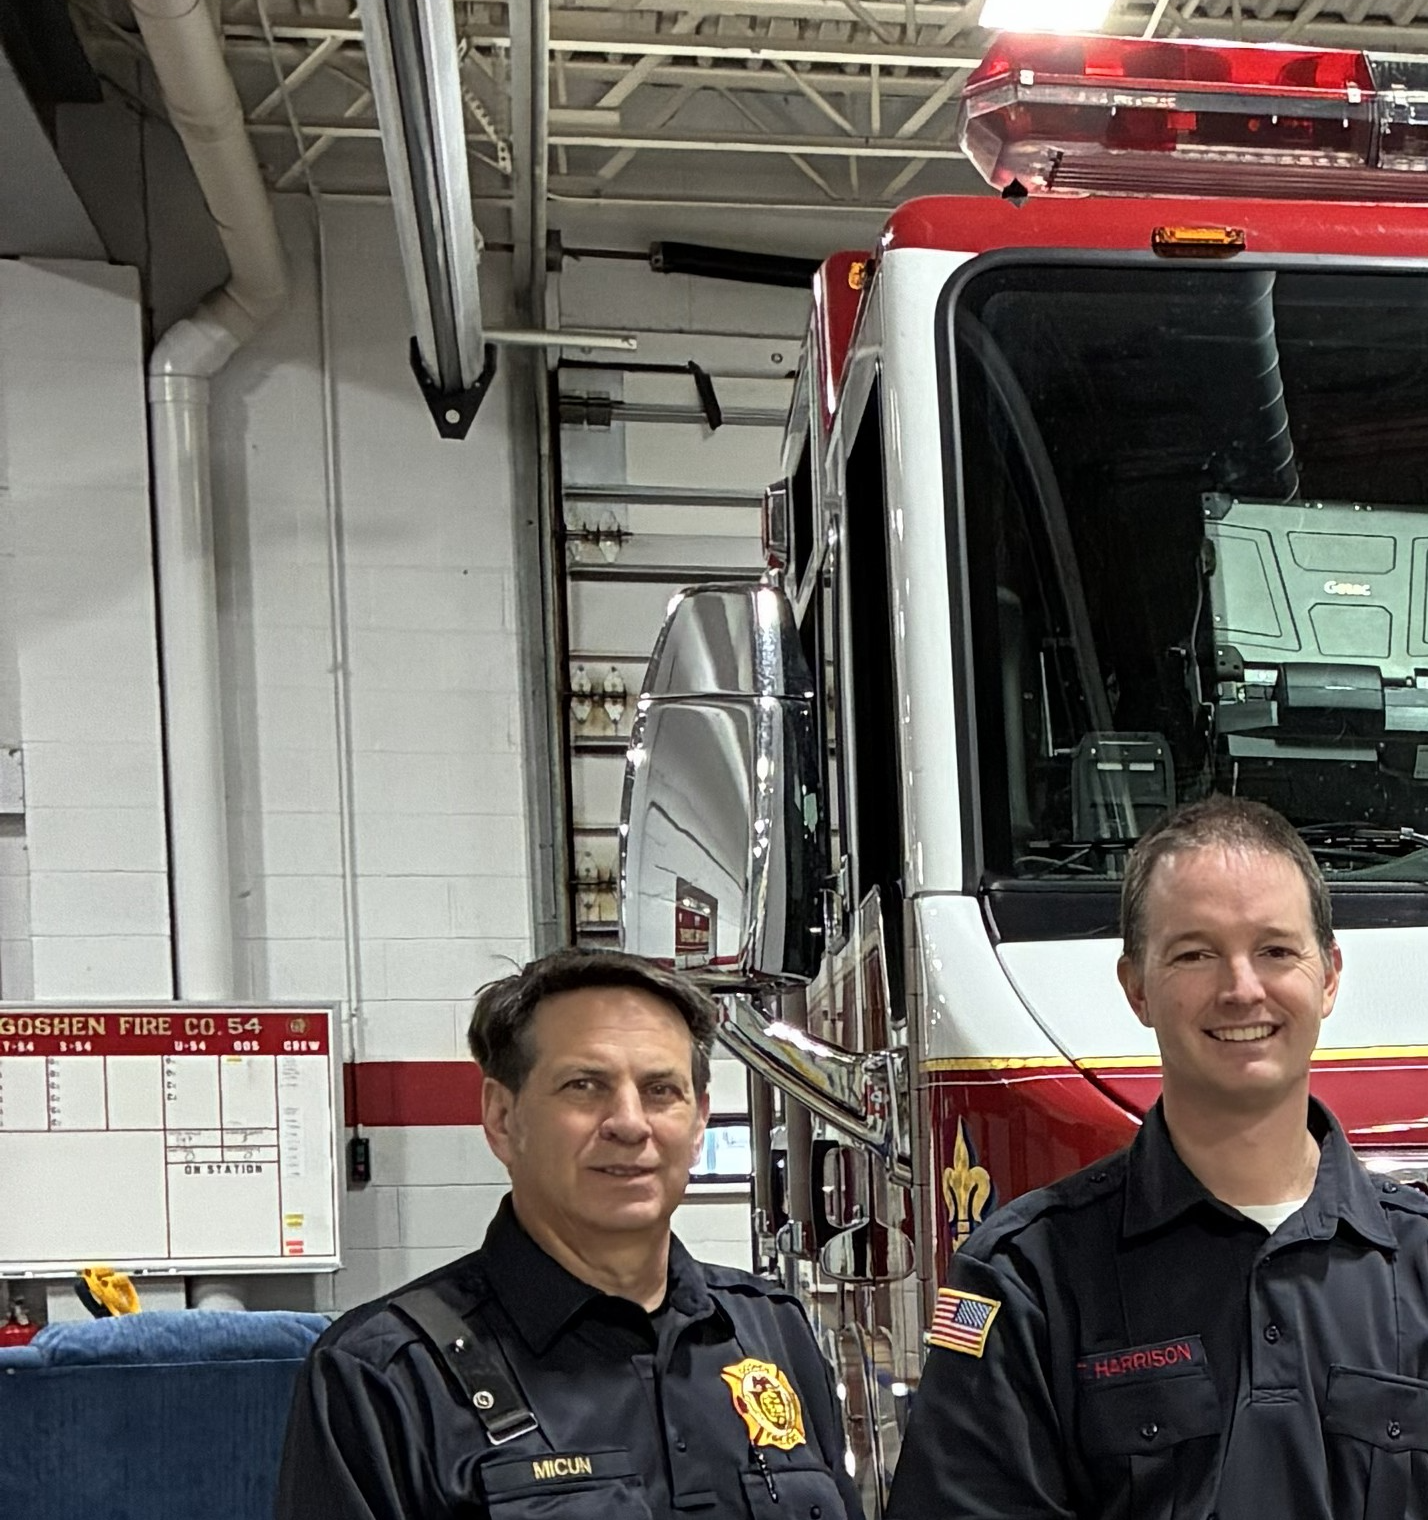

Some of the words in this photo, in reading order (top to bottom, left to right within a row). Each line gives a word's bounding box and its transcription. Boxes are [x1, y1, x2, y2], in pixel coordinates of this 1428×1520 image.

[0, 1017, 106, 1036] GOSHEN
[119, 1017, 172, 1035] FIRE
[227, 1017, 263, 1034] 54
[283, 1040, 320, 1051] CREW
[184, 1165, 201, 1174] ON
[207, 1164, 262, 1174] STATION
[1094, 1343, 1191, 1378] HARRISON
[533, 1456, 592, 1479] MICUN
